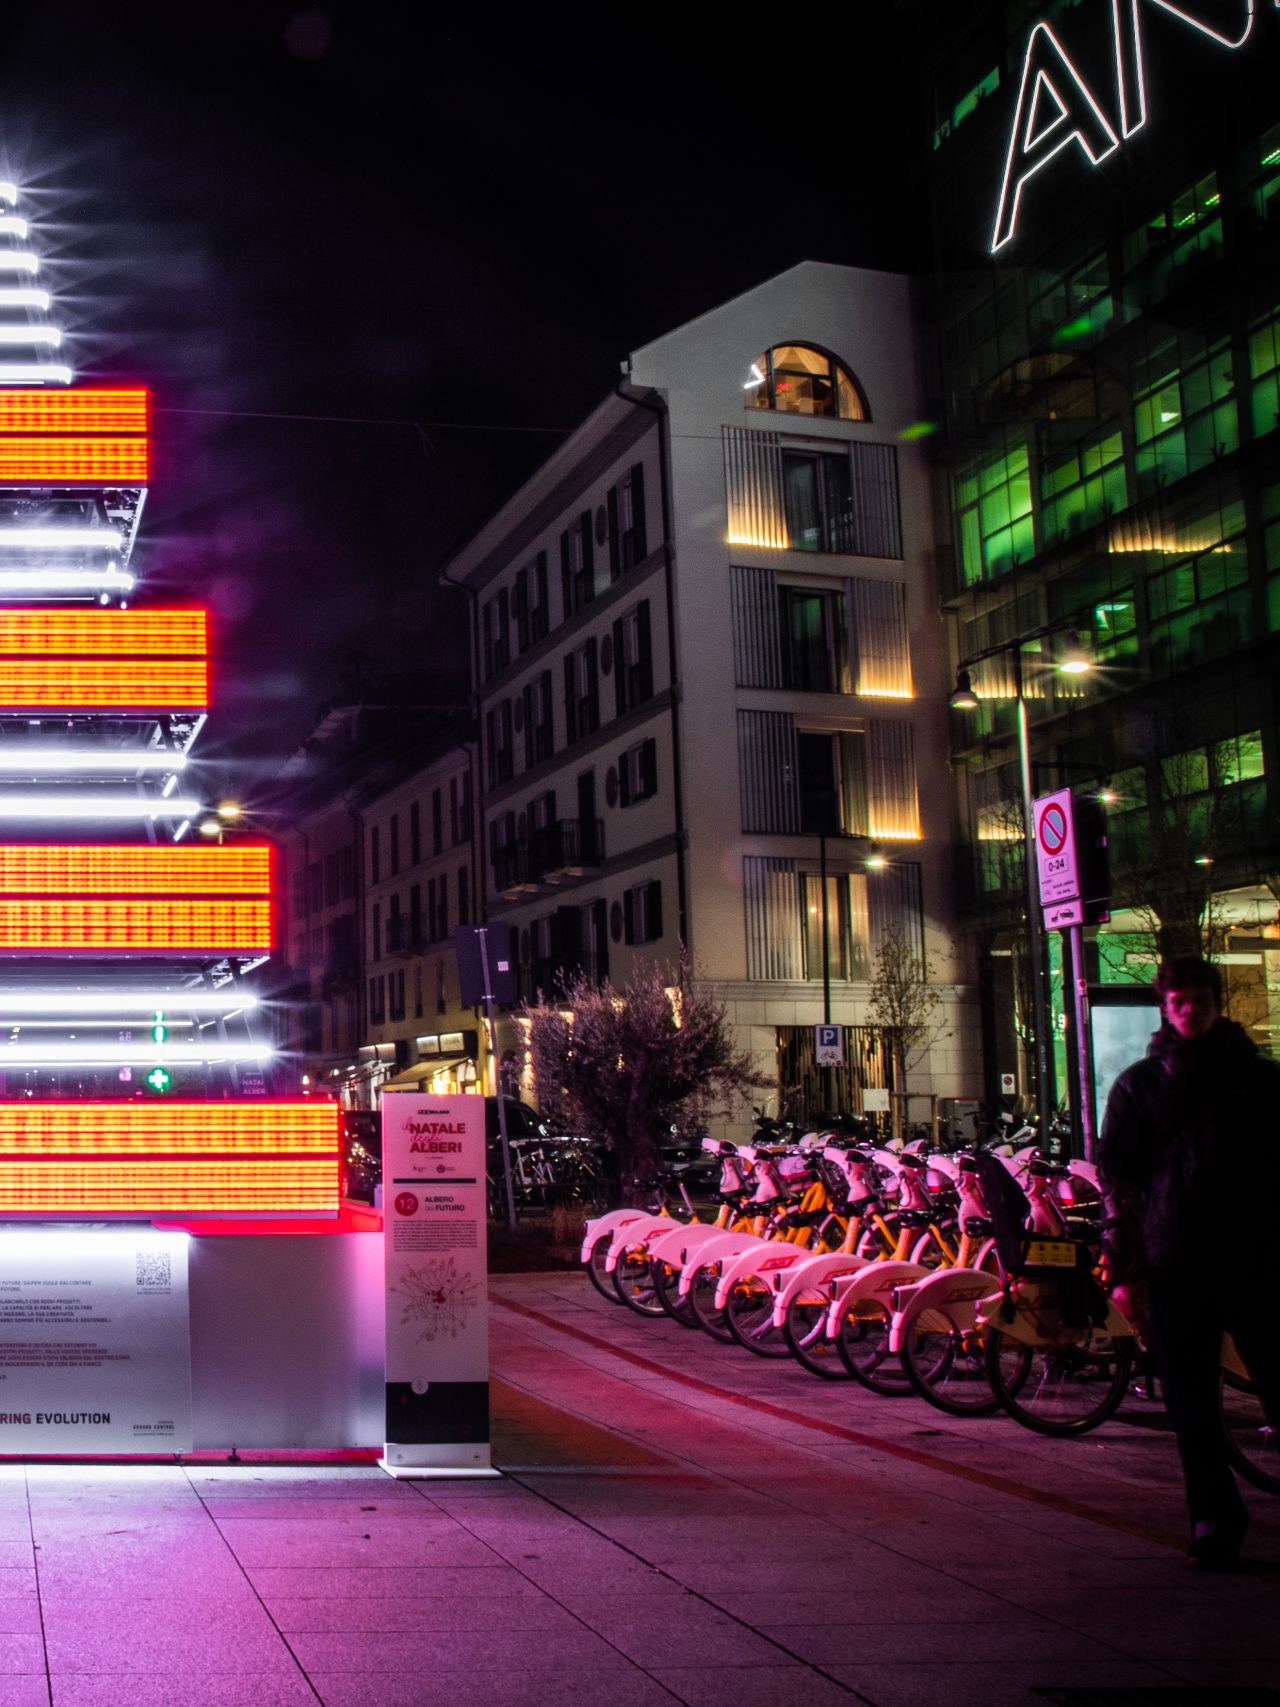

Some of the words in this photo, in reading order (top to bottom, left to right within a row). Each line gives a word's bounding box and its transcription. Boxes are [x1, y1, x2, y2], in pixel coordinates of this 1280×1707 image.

[1048, 858, 1065, 872] 0-24
[823, 1029, 835, 1044] P
[410, 1123, 466, 1134] NATALE
[410, 1142, 462, 1153] ALBERI
[400, 1198, 415, 1210] 12
[36, 1413, 111, 1424] EVOLUTION
